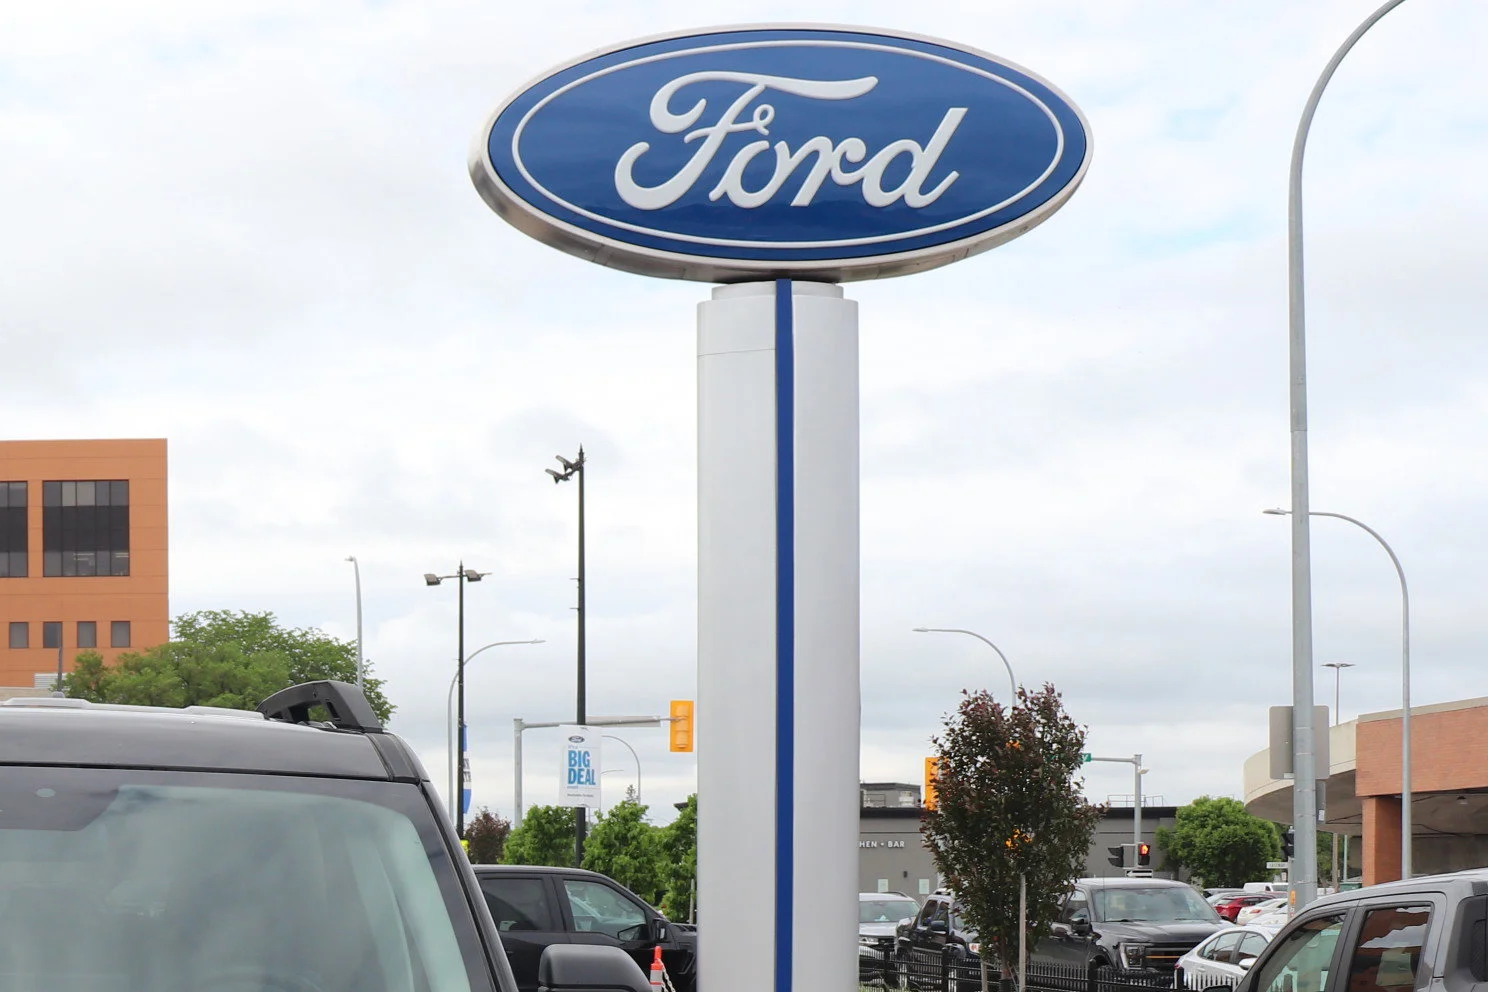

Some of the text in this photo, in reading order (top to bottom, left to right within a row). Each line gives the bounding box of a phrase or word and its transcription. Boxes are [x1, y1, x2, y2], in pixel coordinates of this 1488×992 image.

[615, 70, 968, 211] Ford
[568, 749, 591, 768] BIG
[567, 768, 596, 785] DEAL
[859, 840, 905, 848] HEN BAR
